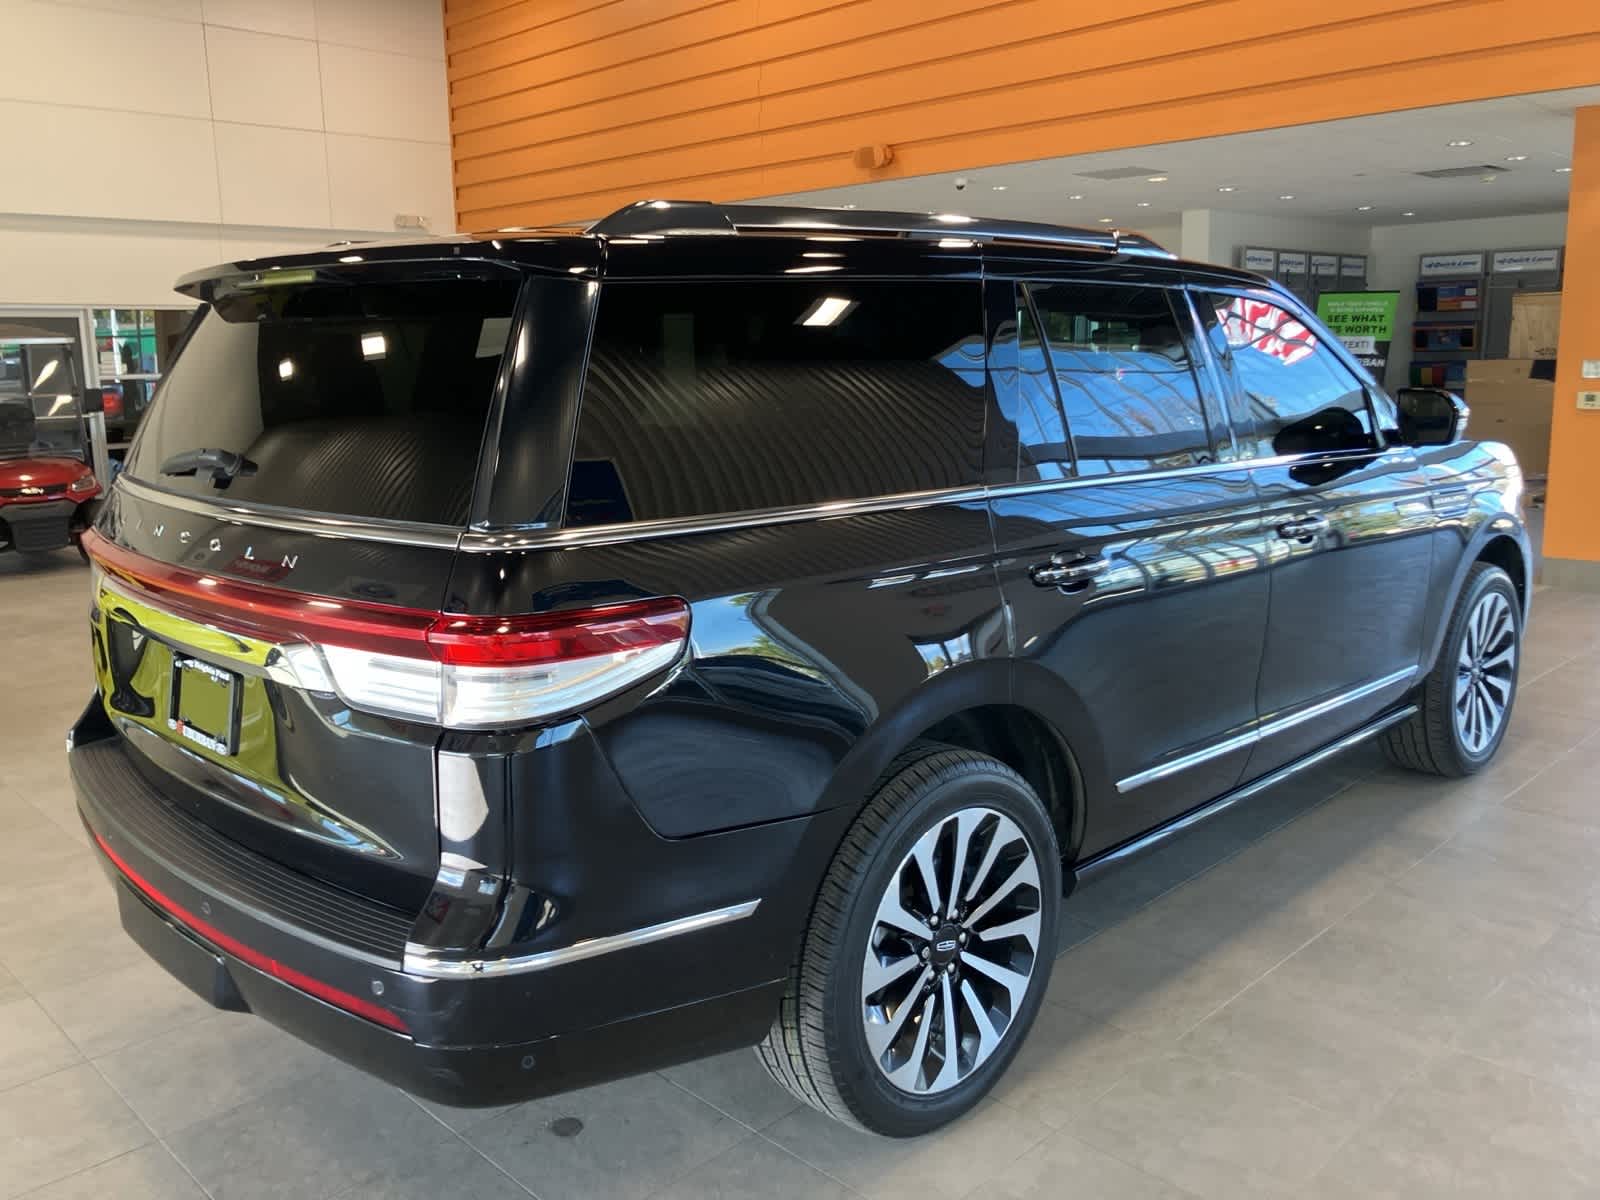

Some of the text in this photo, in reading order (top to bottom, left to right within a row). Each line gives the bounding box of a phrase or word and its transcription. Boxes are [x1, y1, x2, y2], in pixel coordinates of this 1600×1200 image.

[1327, 314, 1385, 323] SEE WHAT
[1344, 325, 1387, 334] WORTH
